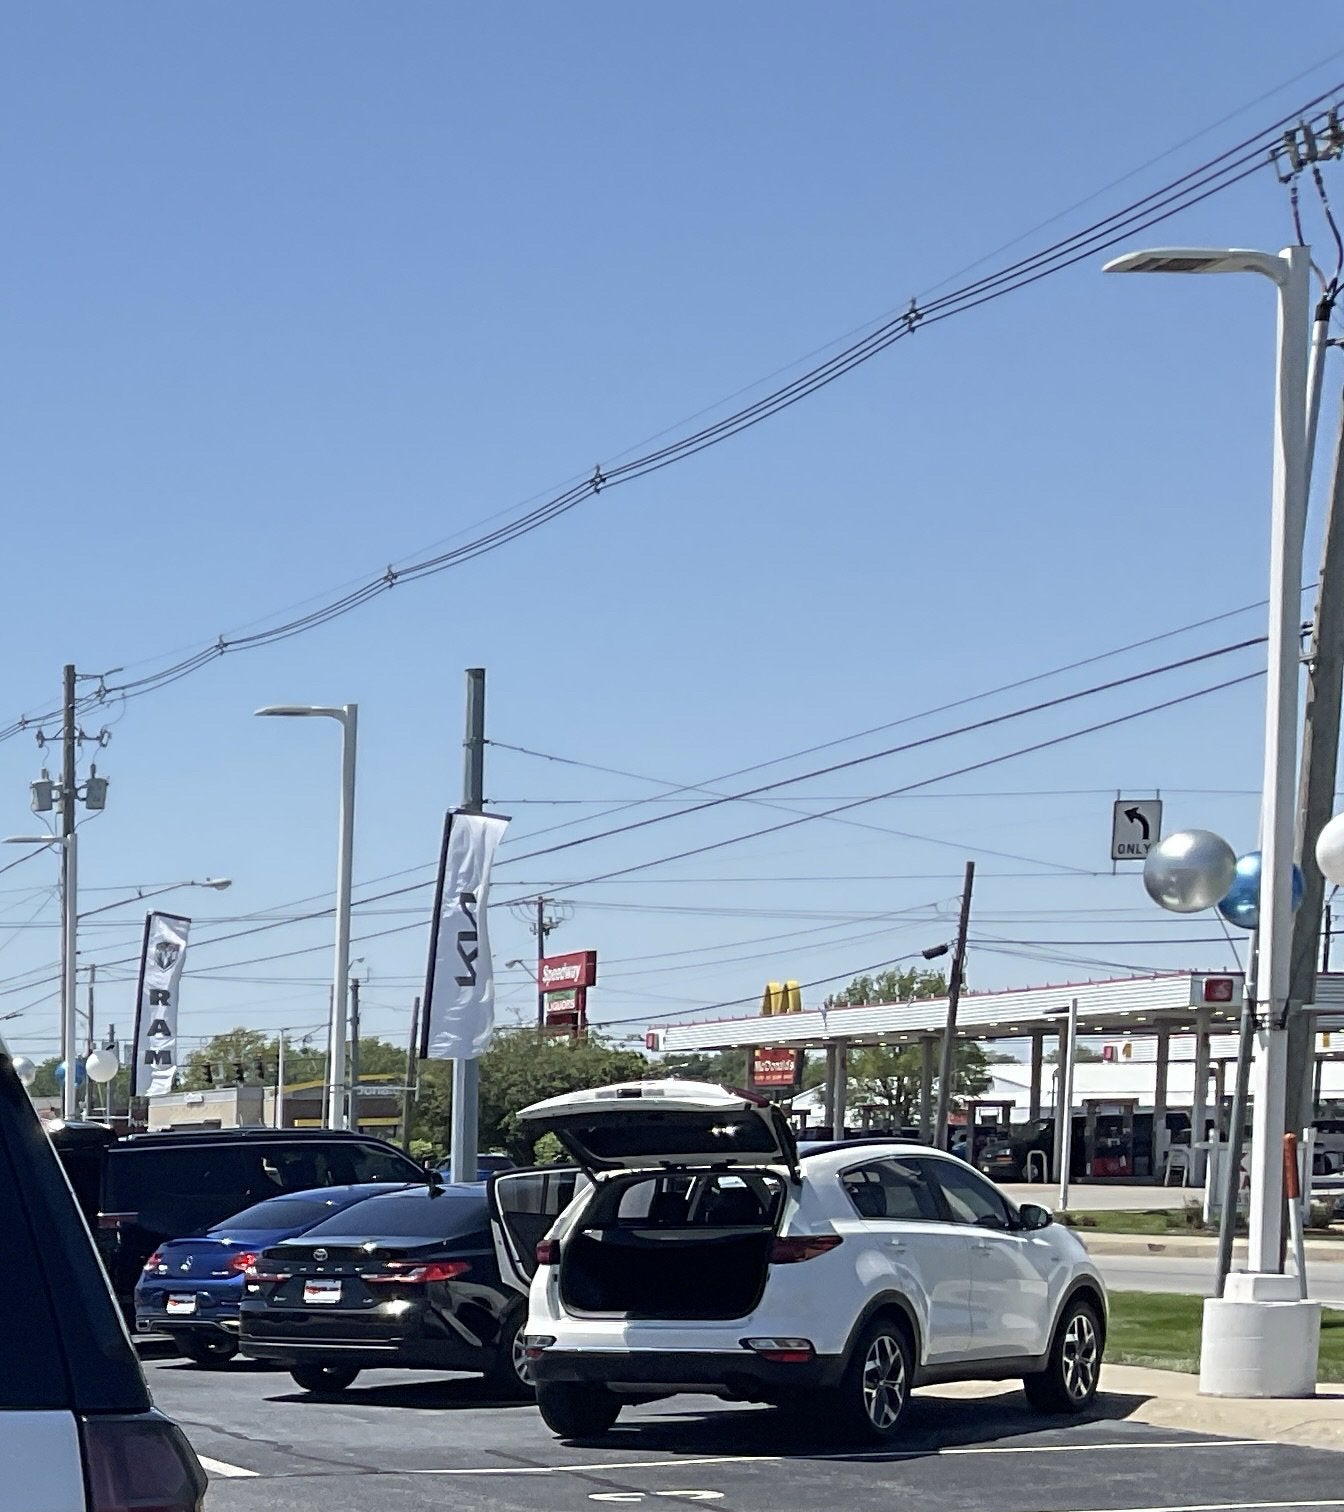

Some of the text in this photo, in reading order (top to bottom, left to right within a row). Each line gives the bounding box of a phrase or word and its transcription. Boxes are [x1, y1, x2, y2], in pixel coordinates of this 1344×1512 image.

[1117, 843, 1152, 855] ONLY
[542, 962, 581, 987] Speedway
[144, 989, 172, 1065] RAM
